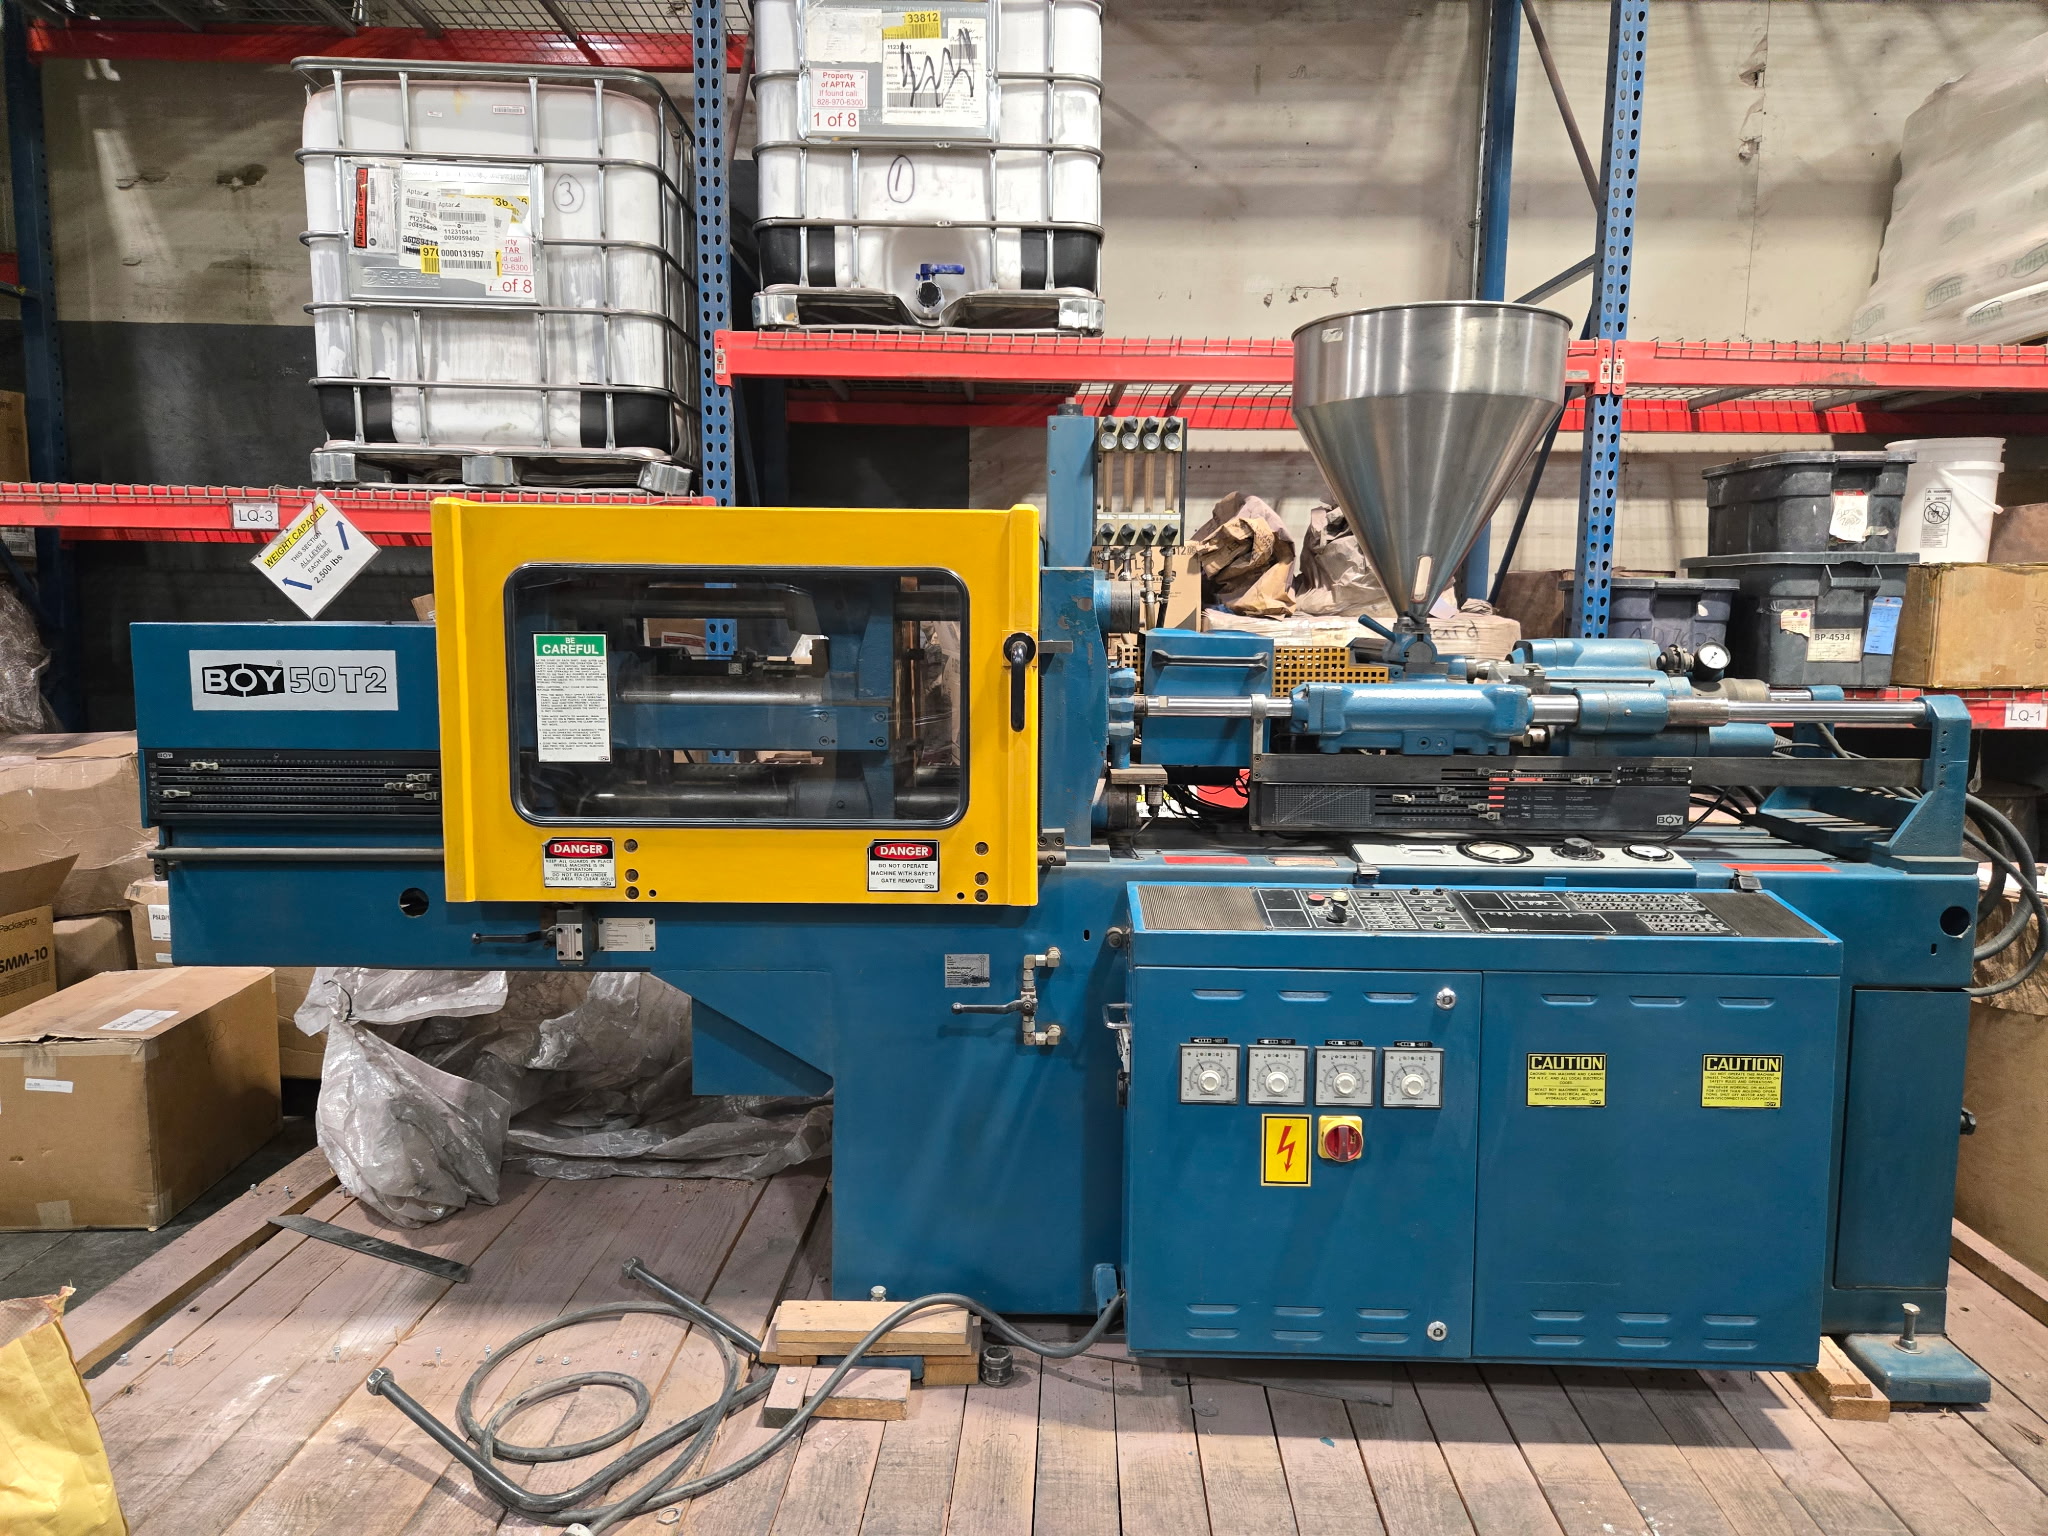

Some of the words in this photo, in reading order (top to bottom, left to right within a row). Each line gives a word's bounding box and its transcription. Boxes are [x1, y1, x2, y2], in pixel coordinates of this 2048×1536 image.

[822, 72, 854, 80] Property
[813, 112, 820, 126] 1
[827, 112, 843, 127] of
[847, 112, 857, 127] 8
[406, 188, 423, 196] Aptar
[559, 181, 574, 206] 3
[441, 249, 484, 258] 0000131957
[502, 279, 518, 292] of
[523, 279, 532, 293] 8
[238, 509, 274, 523] LQ-3
[264, 538, 293, 568] WEIGHT
[292, 504, 327, 541] CAPACITY
[290, 550, 303, 563] THIS
[302, 531, 322, 552] SECTION
[300, 557, 310, 569] ALL
[307, 559, 322, 573] EACH
[320, 547, 333, 561] SIDE
[313, 564, 333, 584] 2,500
[329, 554, 344, 567] lbs
[1814, 633, 1851, 641] BP-4534
[542, 644, 600, 655] CAREFUL
[203, 667, 283, 693] BOY
[289, 665, 387, 694] 50T2
[2009, 709, 2041, 722] LQ-1
[1657, 816, 1682, 824] BOY
[554, 844, 603, 854] DANGER
[880, 846, 929, 856] DANGER
[1531, 1056, 1603, 1070] CAUTION
[1706, 1058, 1779, 1071] CAUTION
